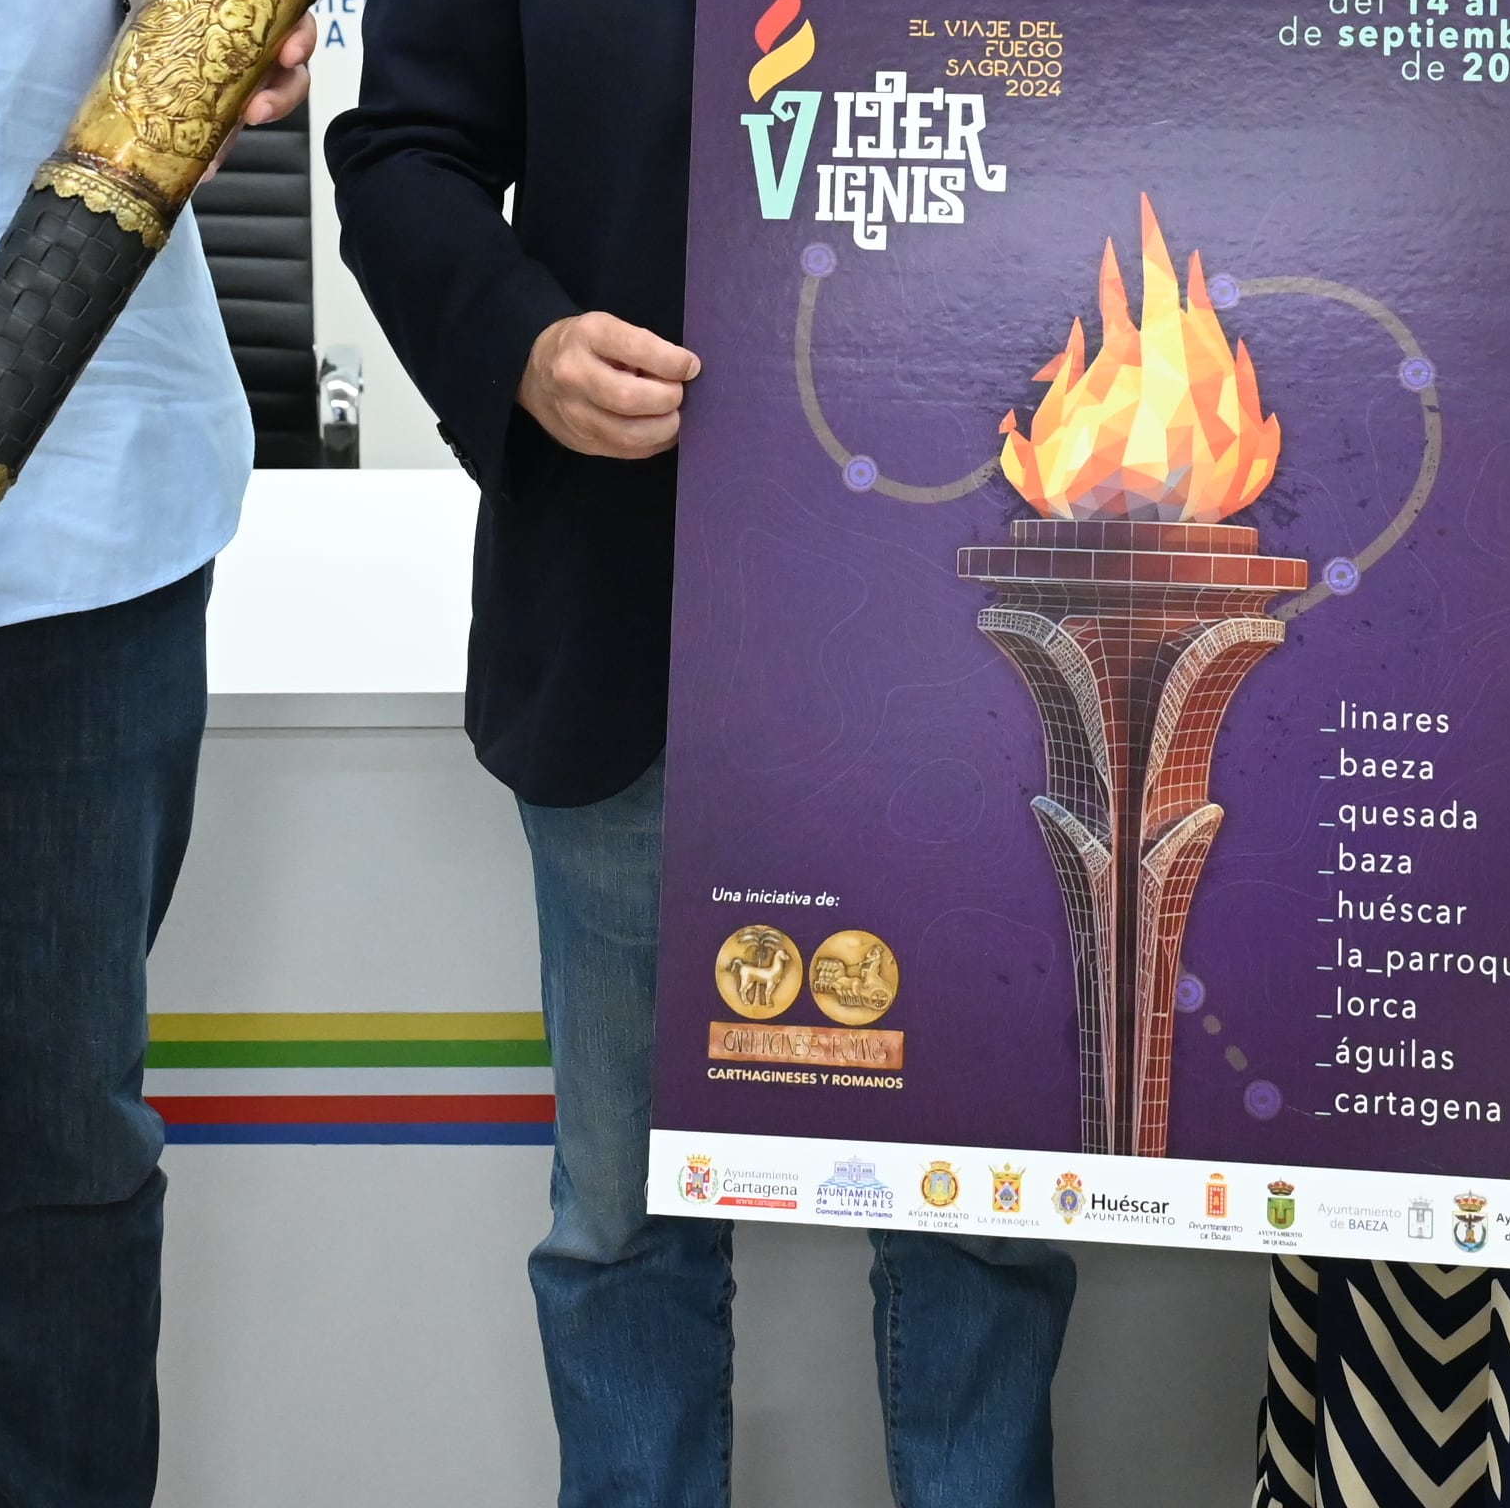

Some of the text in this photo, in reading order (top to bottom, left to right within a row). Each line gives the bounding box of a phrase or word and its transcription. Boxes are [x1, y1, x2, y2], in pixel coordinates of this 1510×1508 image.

[909, 19, 1063, 39] EL VIAJE DEL
[1279, 16, 1322, 46] de
[986, 40, 1063, 58] FUEGO
[946, 59, 1062, 77] SAGRADO
[1401, 50, 1445, 81] de
[1005, 80, 1061, 97] 2024
[815, 164, 965, 250] IGNIS
[1320, 701, 1450, 733] _linares
[1319, 748, 1434, 780] _baeza
[1318, 801, 1478, 832] _quesada
[1318, 843, 1413, 875] _baza
[712, 887, 840, 907] Una iniciativa de:
[1317, 890, 1467, 924] _huéscar
[1316, 986, 1417, 1020] _lorca
[1315, 1038, 1454, 1073] _águilas
[707, 1067, 903, 1089] CARTHAGINESES Y ROMANOS
[1314, 1090, 1501, 1126] _cartagena
[724, 1167, 799, 1181] Ayuntamiento
[723, 1179, 797, 1197] Cartagena
[817, 1187, 894, 1200] AYUNTAMIENTO
[816, 1197, 893, 1209] de LINARES
[1091, 1193, 1170, 1214] Huéscar
[1318, 1203, 1402, 1219] Ayuntamiento
[866, 1211, 893, 1219] Turismo
[908, 1210, 970, 1220] AYUNTAMIENTO
[933, 1221, 959, 1229] LORCA
[1084, 1212, 1175, 1226] AYUNTAMIENTO
[1329, 1219, 1389, 1232] de BAEZA
